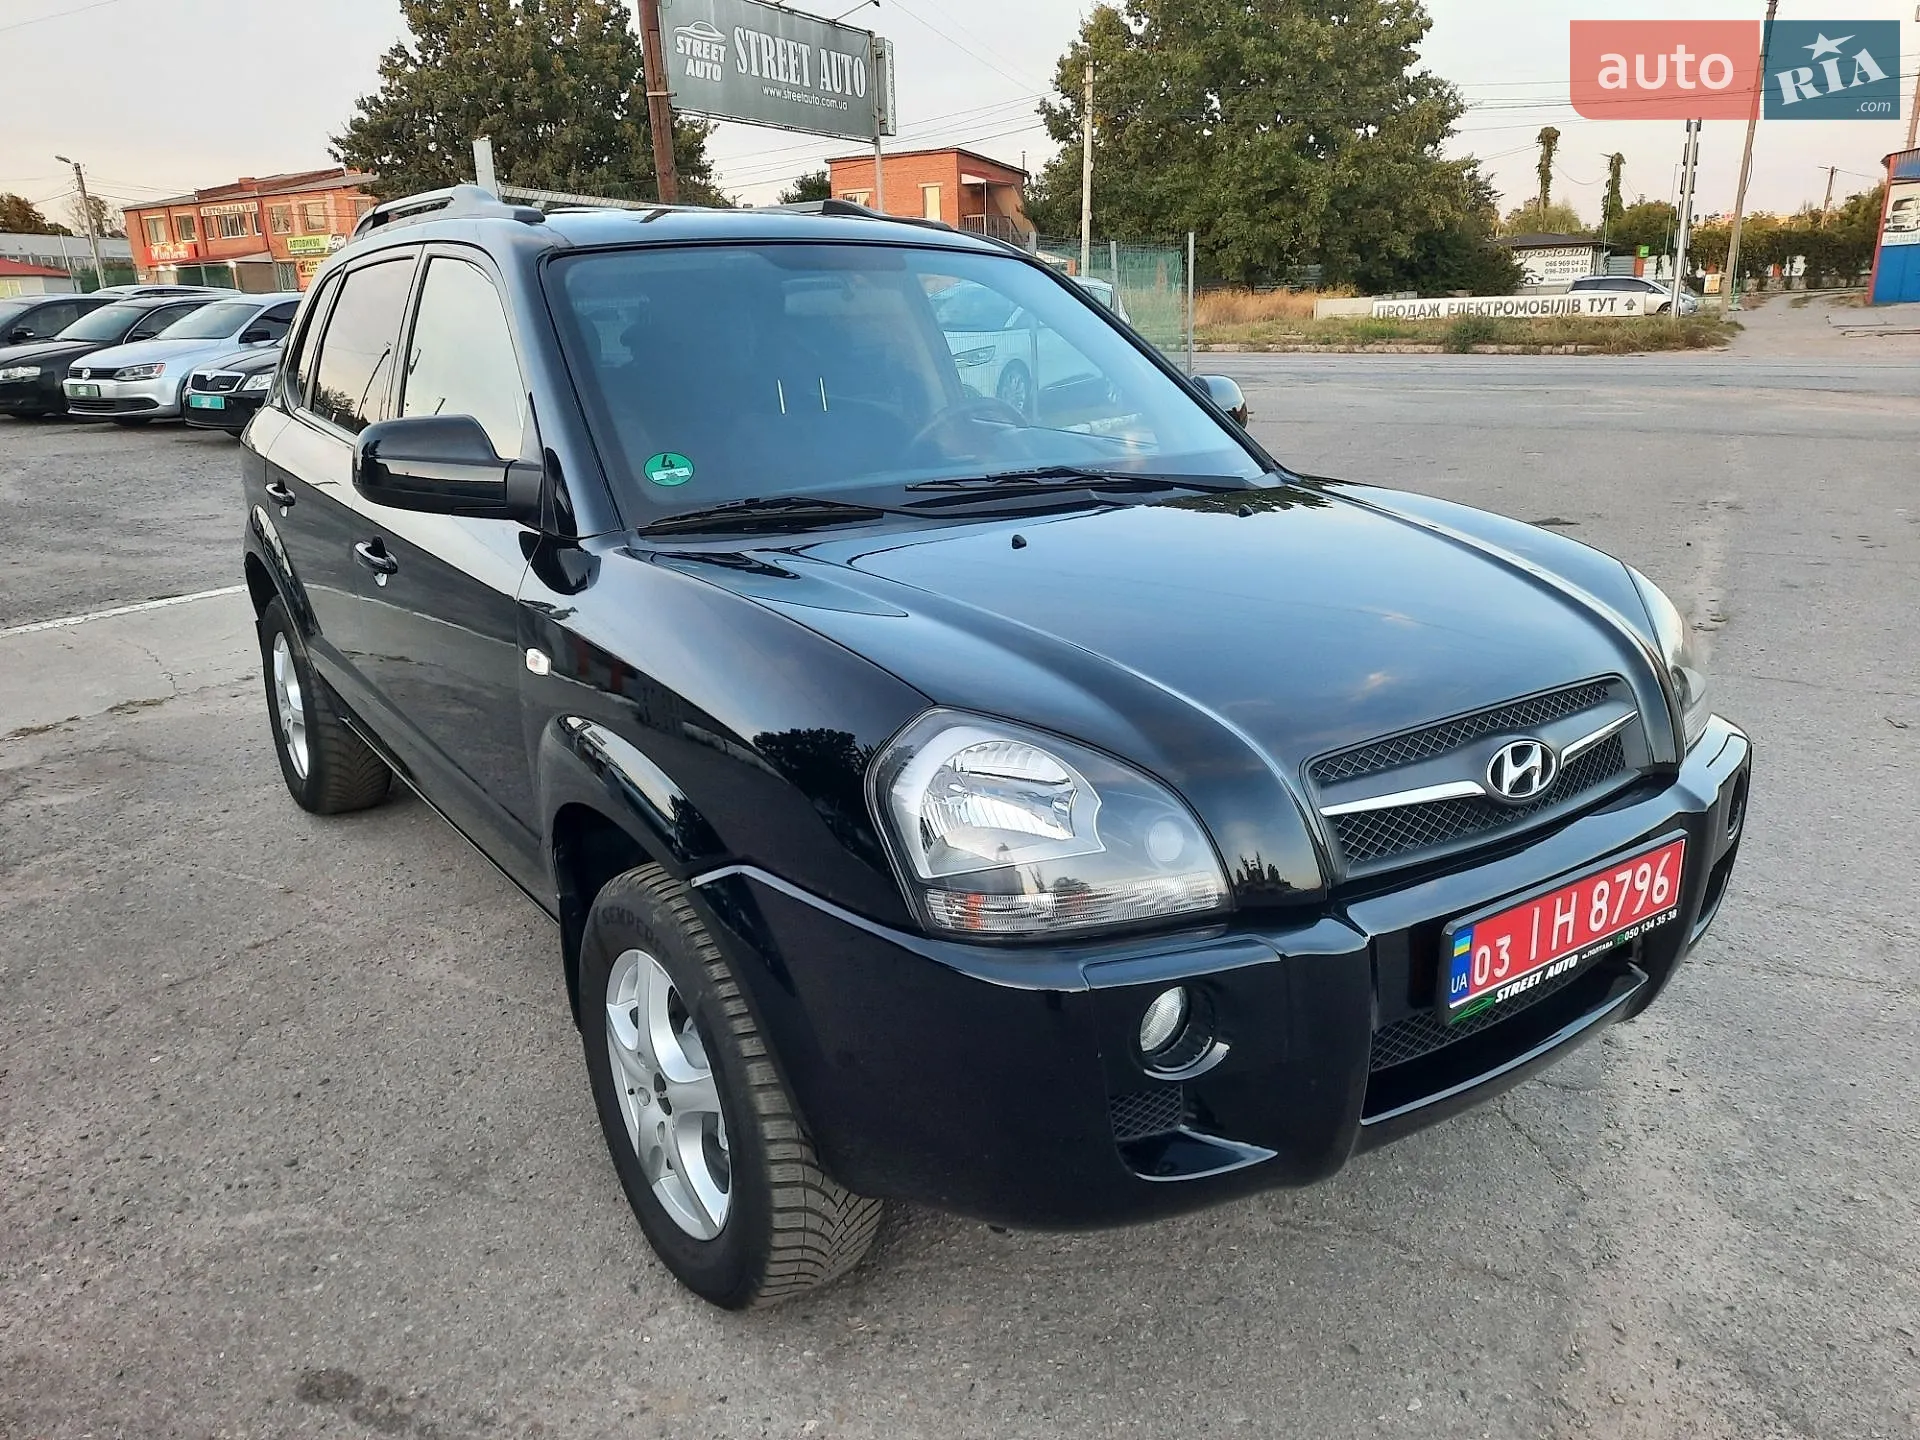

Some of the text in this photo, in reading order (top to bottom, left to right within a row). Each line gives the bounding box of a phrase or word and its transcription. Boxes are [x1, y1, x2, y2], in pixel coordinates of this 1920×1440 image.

[676, 36, 727, 63] STREET
[734, 26, 811, 88] STREET
[819, 48, 866, 98] AUTO
[685, 58, 722, 82] AUTO
[762, 85, 848, 111] www.streetauto.com.ua
[1376, 297, 1618, 320] ПРОДАЖ ЕЛЕКТРОМОБІЛІВ ТУТ
[660, 454, 676, 469] 4
[1473, 851, 1671, 986] 03 IH 8796
[1495, 970, 1544, 1004] STREET
[1545, 954, 1578, 980] AUTO
[1624, 926, 1639, 941] 050
[1640, 918, 1655, 933] 134
[1656, 912, 1667, 926] 35
[1451, 972, 1468, 993] UA
